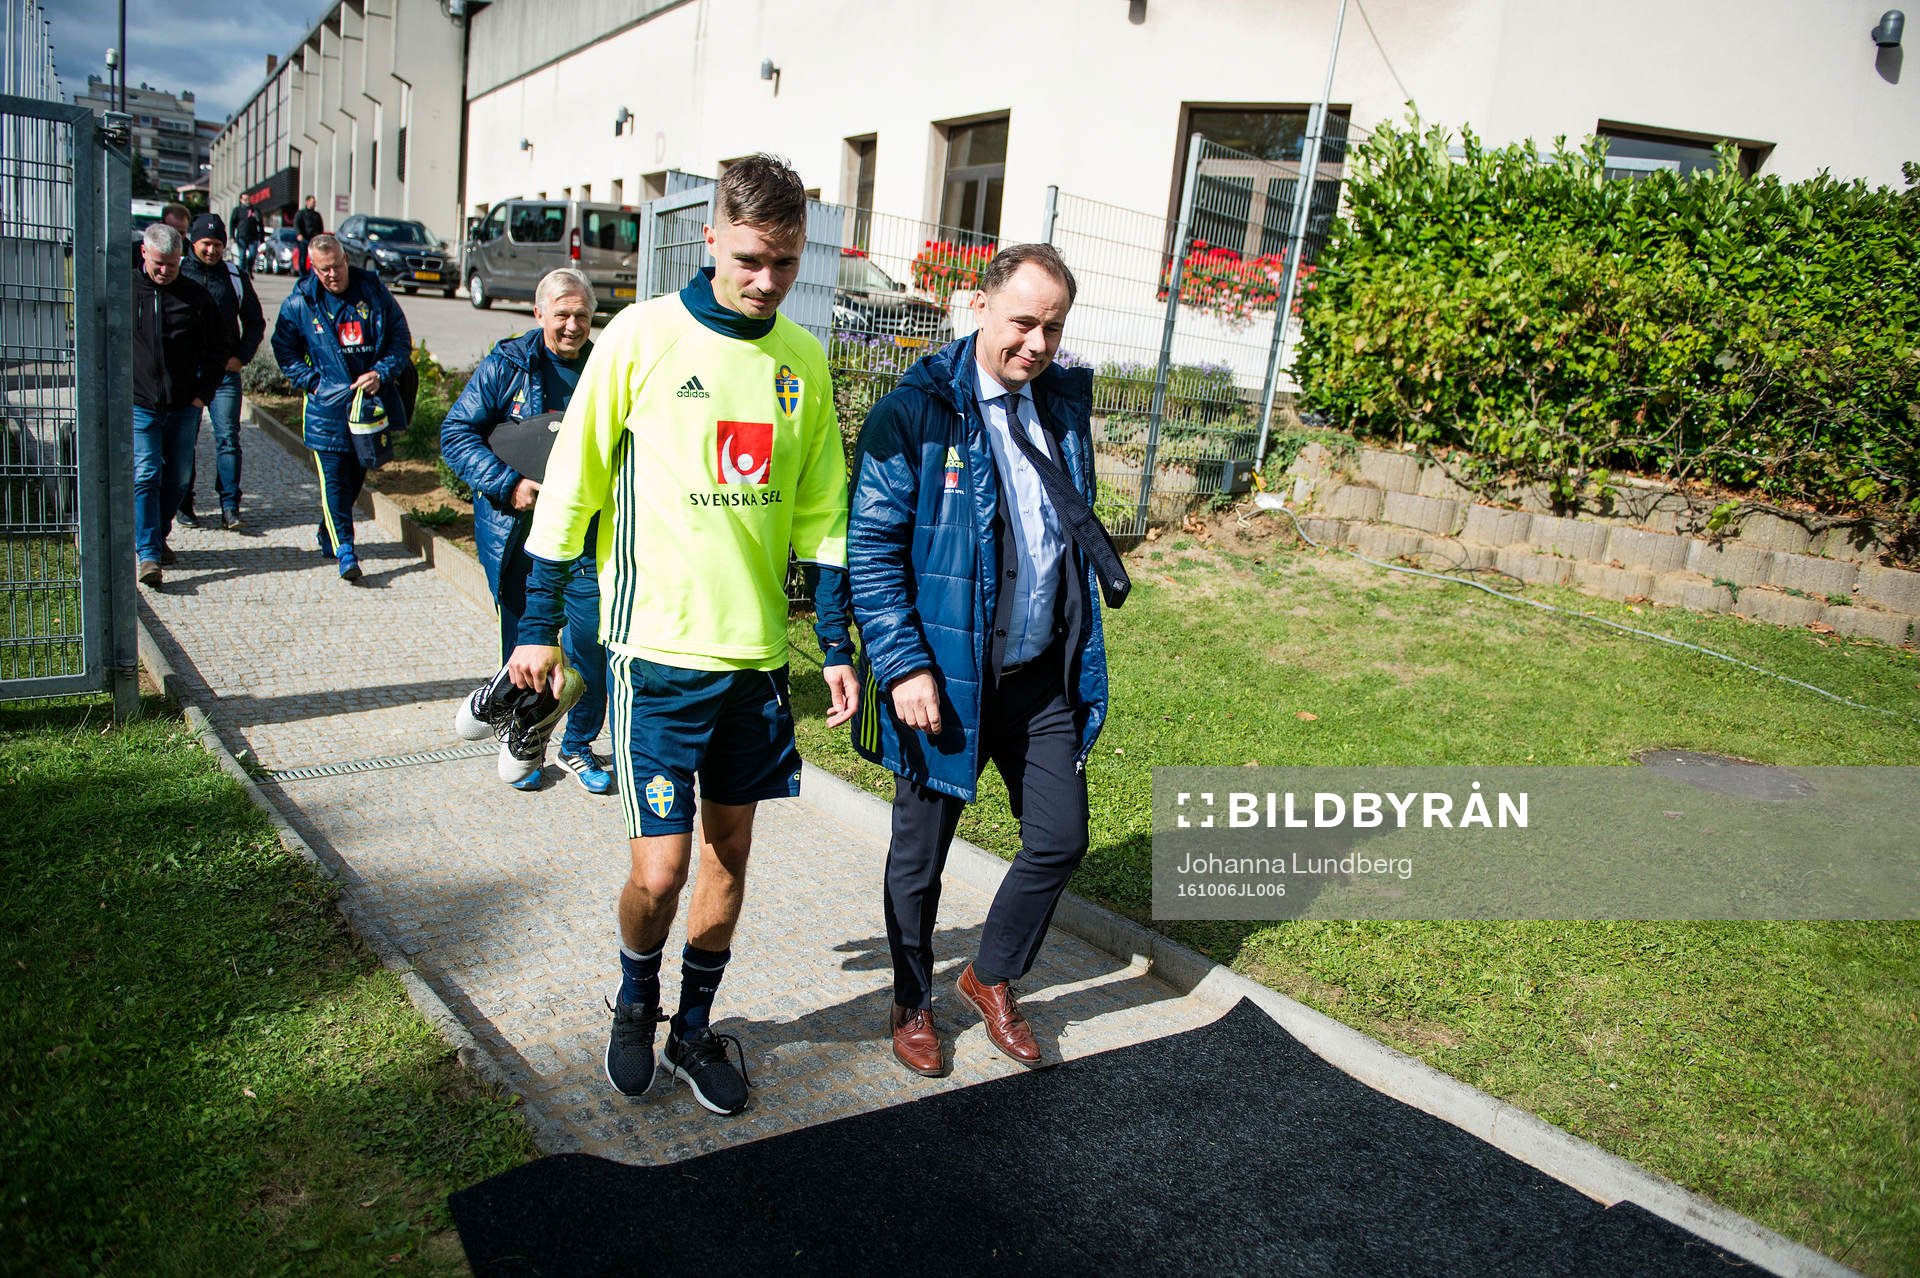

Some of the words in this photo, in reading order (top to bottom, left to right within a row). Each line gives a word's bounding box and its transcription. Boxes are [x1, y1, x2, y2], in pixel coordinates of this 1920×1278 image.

[335, 195, 349, 212] E
[676, 389, 710, 399] adidas
[689, 493, 758, 507] SVENSKA
